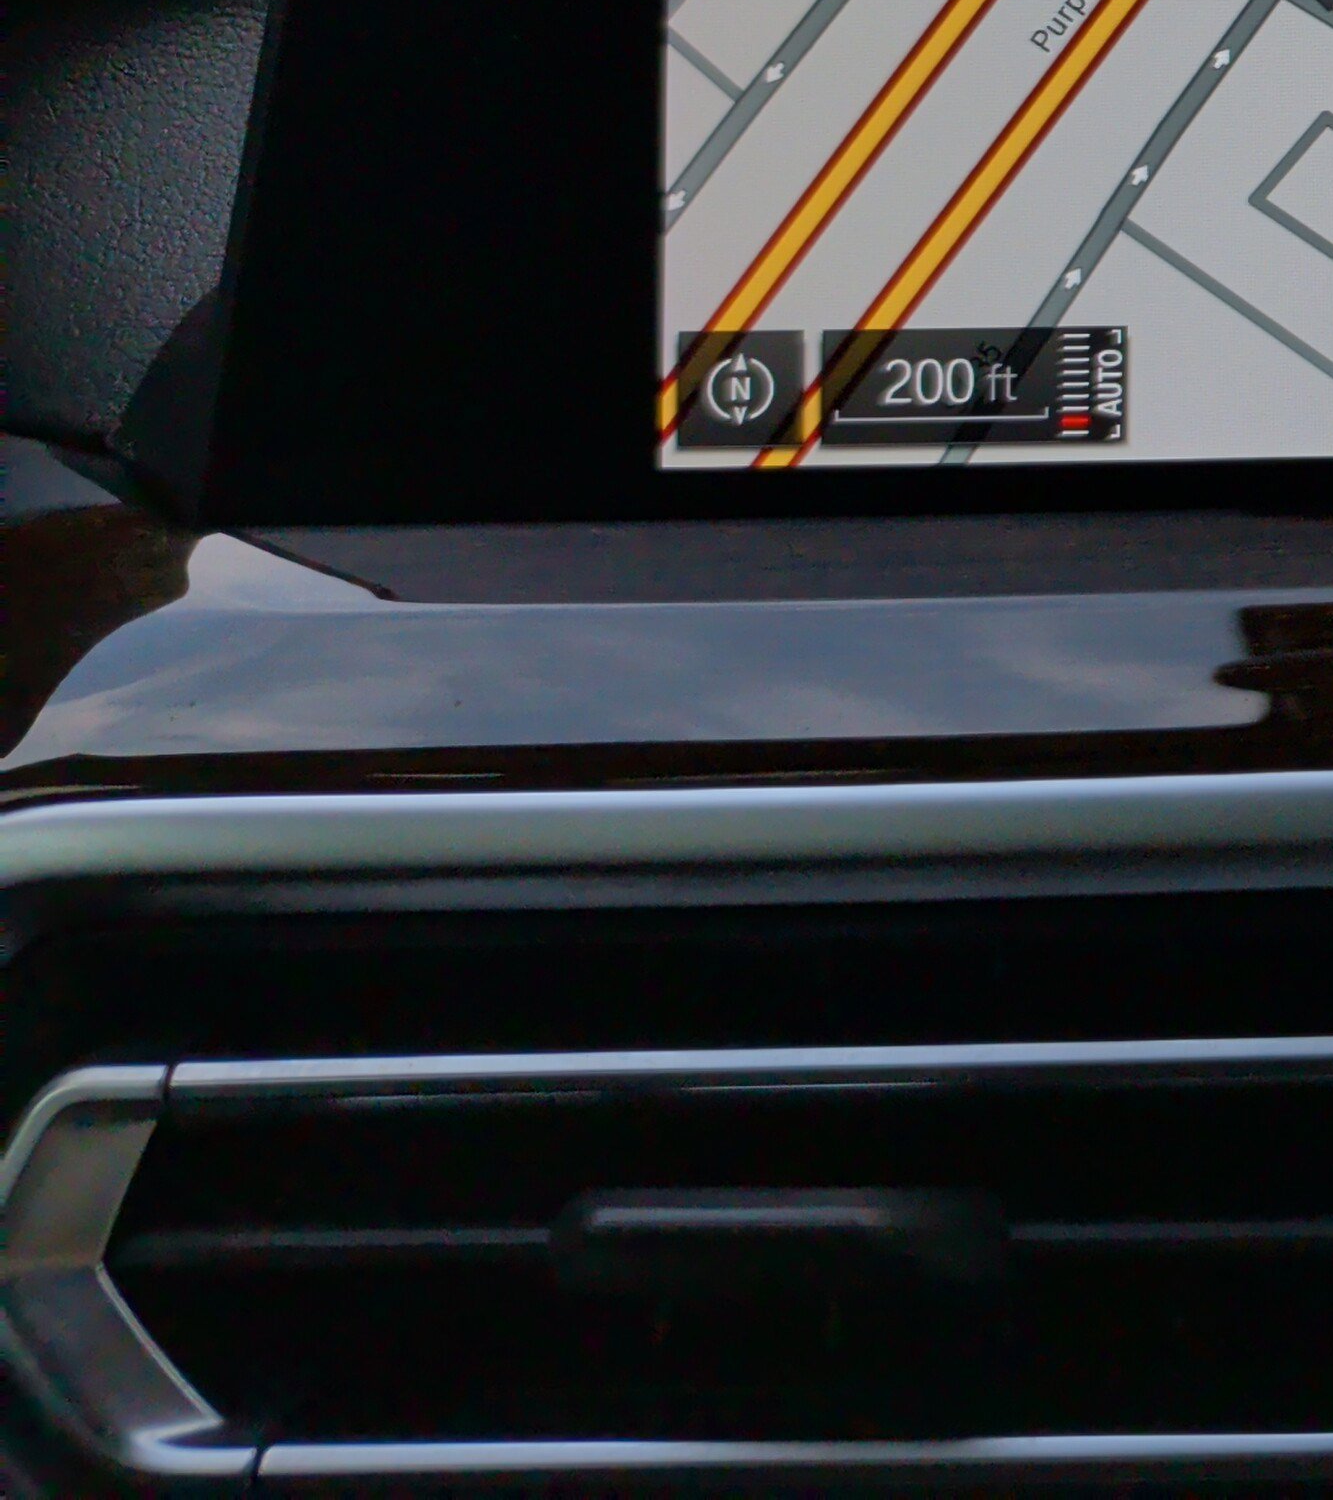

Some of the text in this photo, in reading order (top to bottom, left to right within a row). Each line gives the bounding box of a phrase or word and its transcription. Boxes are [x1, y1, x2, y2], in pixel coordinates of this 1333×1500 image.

[731, 376, 751, 401] N
[883, 357, 1019, 406] 200 ft
[1097, 348, 1123, 417] AUTO
